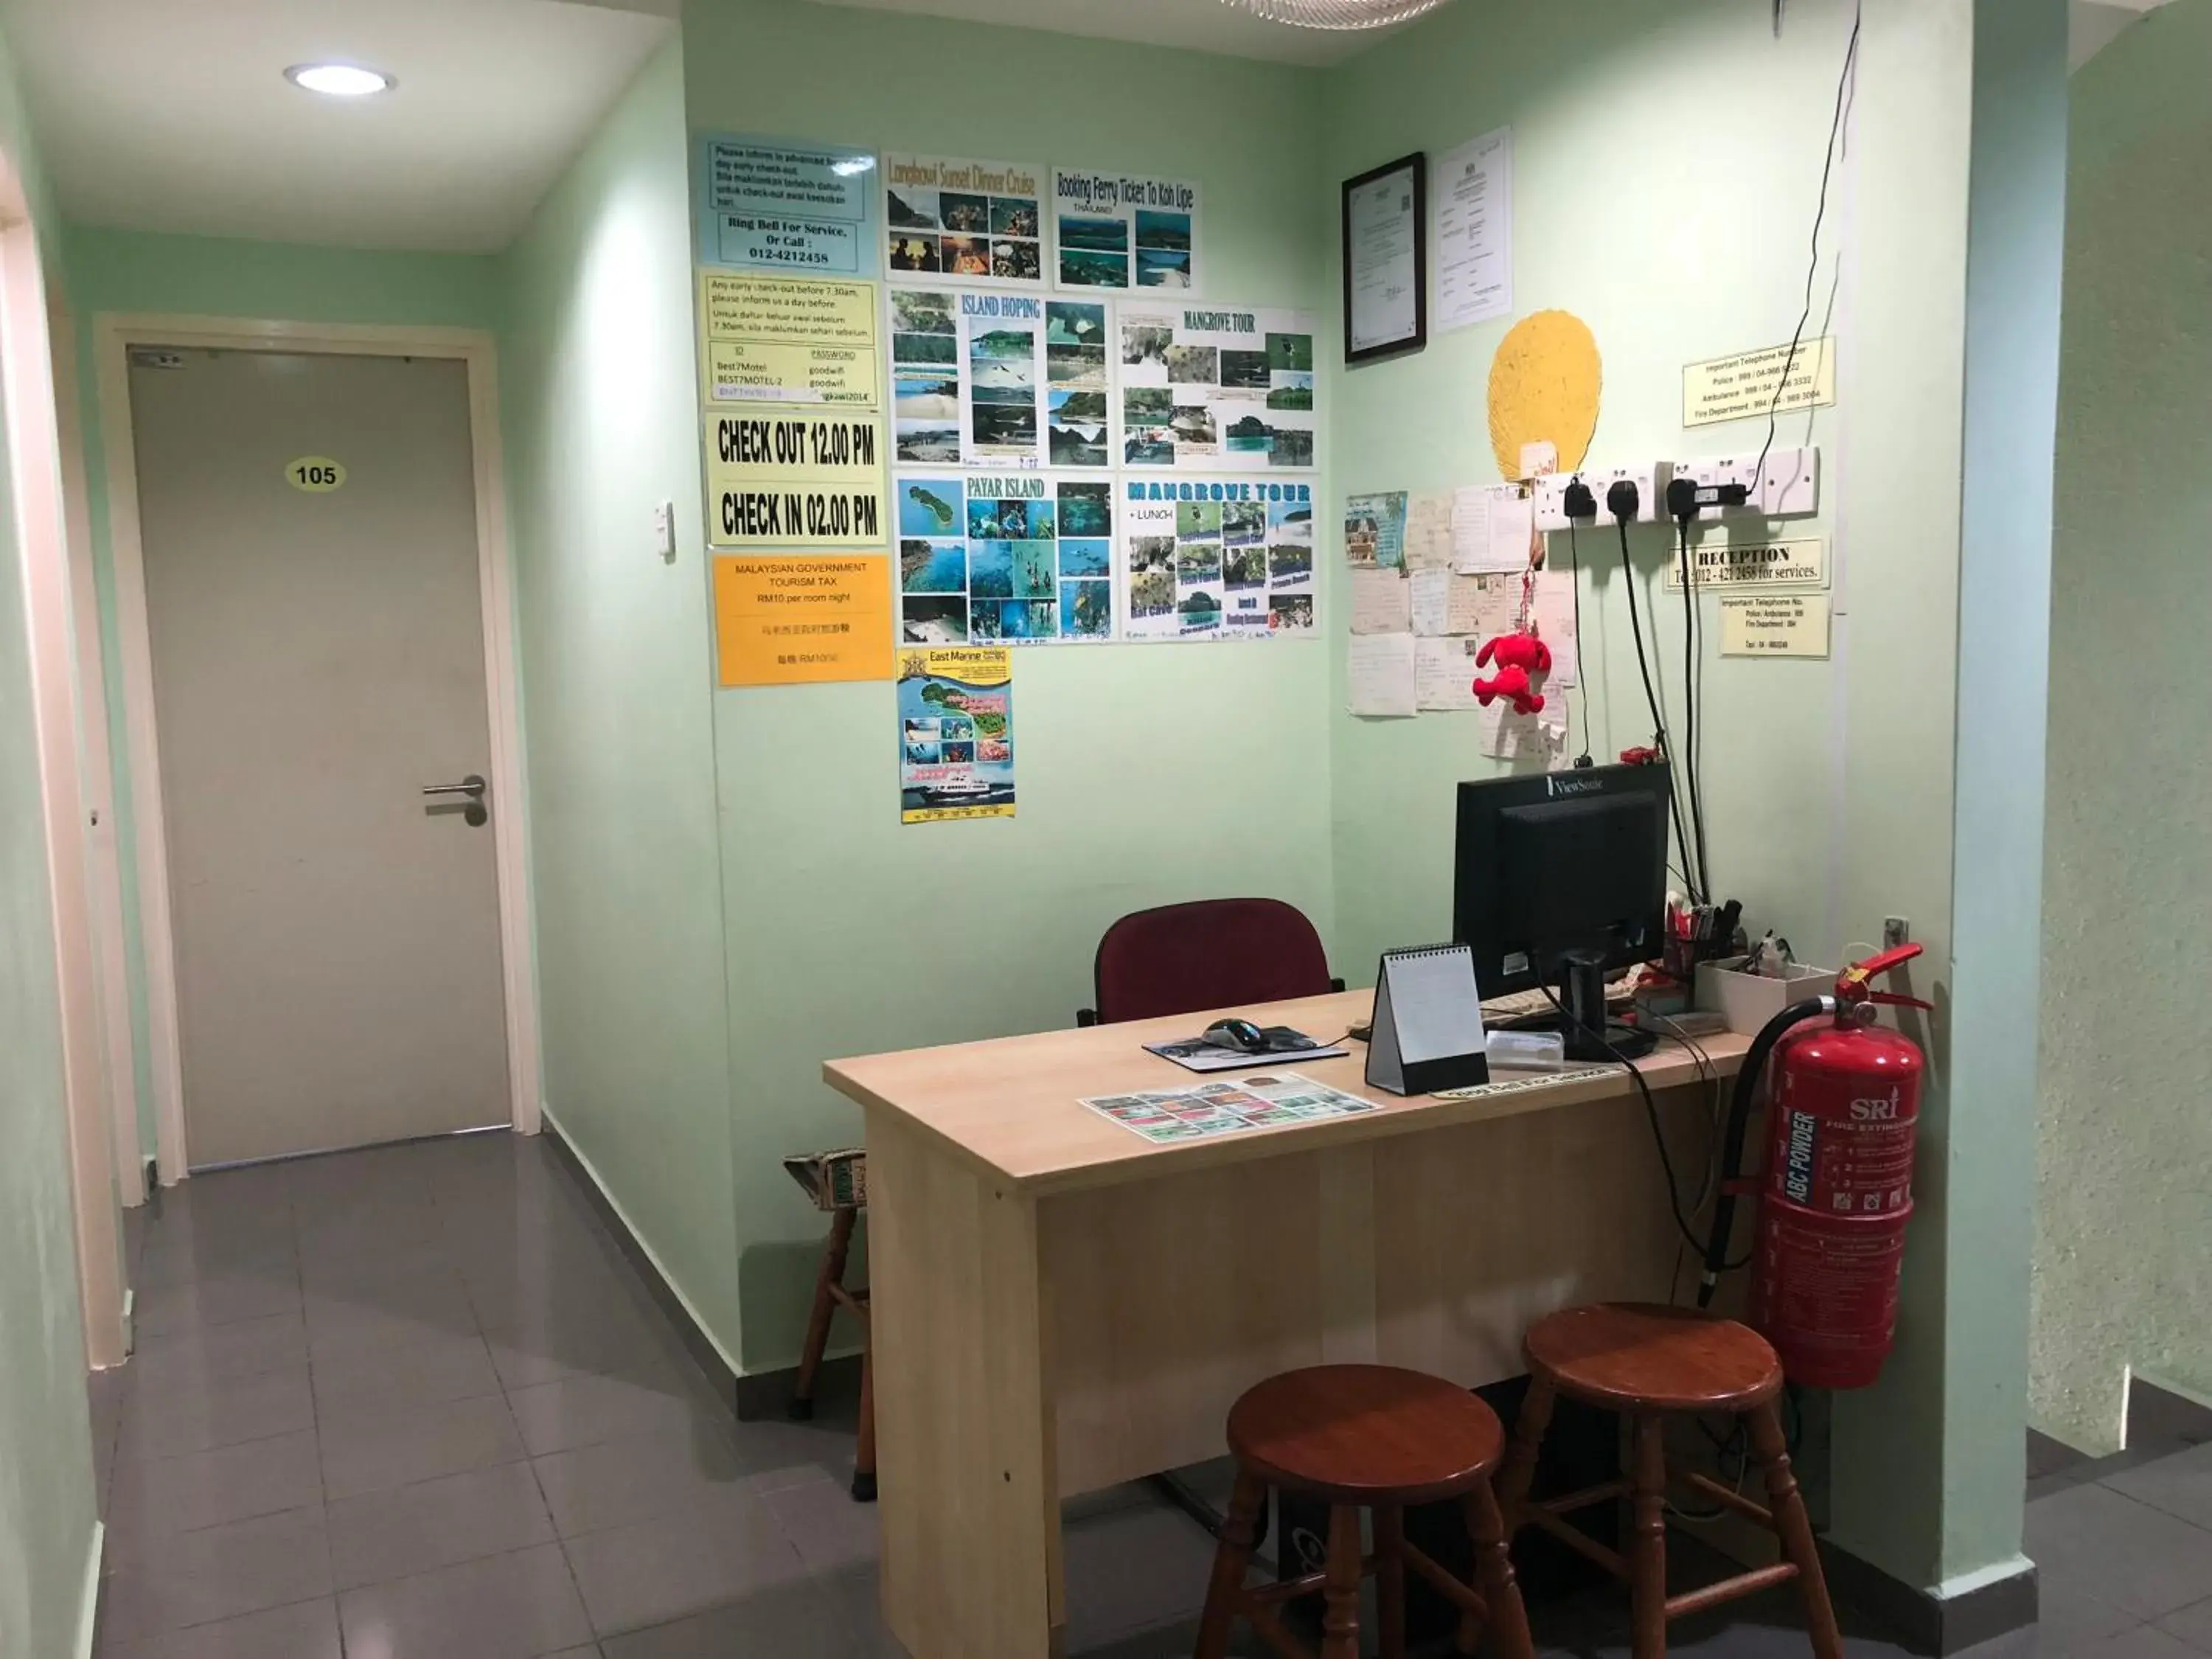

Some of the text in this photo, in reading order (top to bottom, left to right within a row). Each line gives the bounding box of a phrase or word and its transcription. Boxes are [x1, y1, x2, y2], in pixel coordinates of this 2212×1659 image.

[888, 157, 1035, 195] Langkawi Sunset Dinner Cruise
[1057, 172, 1194, 212] Booking Ferry Ticket To Koh Lipe
[1074, 204, 1113, 214] THAILAND
[728, 218, 754, 231] Ring
[758, 218, 779, 230] Bell
[783, 220, 801, 232] For
[767, 234, 780, 246] Or
[784, 236, 804, 247] Call
[749, 247, 829, 263] 012-4212458
[712, 293, 740, 304] please
[742, 295, 771, 304] inform
[961, 295, 1040, 319] ISLAND HOPING
[1184, 310, 1255, 333] MANGROVE TOUR
[719, 420, 874, 465] CHECK OUT 12.00 PM
[296, 465, 336, 484] 105
[967, 478, 1044, 498] PAYAR ISLAND
[1127, 481, 1310, 502] MANGROVE TOUR
[722, 493, 877, 536] CHECK IN 02.00 PM
[1138, 509, 1174, 521] LUNCH
[1699, 547, 1790, 566] RECEPTION
[736, 563, 867, 574] MALAYSIAN GOVERNMENT
[1759, 564, 1773, 580] for
[1775, 563, 1818, 578] services.
[769, 578, 837, 586] TOURISM TAX
[758, 594, 784, 602] RM10
[787, 595, 801, 603] per
[829, 594, 850, 603] night
[1131, 603, 1174, 619] Bat Cave
[930, 650, 949, 661] East
[950, 650, 981, 662] Marine
[1789, 1110, 1816, 1172] POWDER
[1786, 1171, 1809, 1203] ABC
